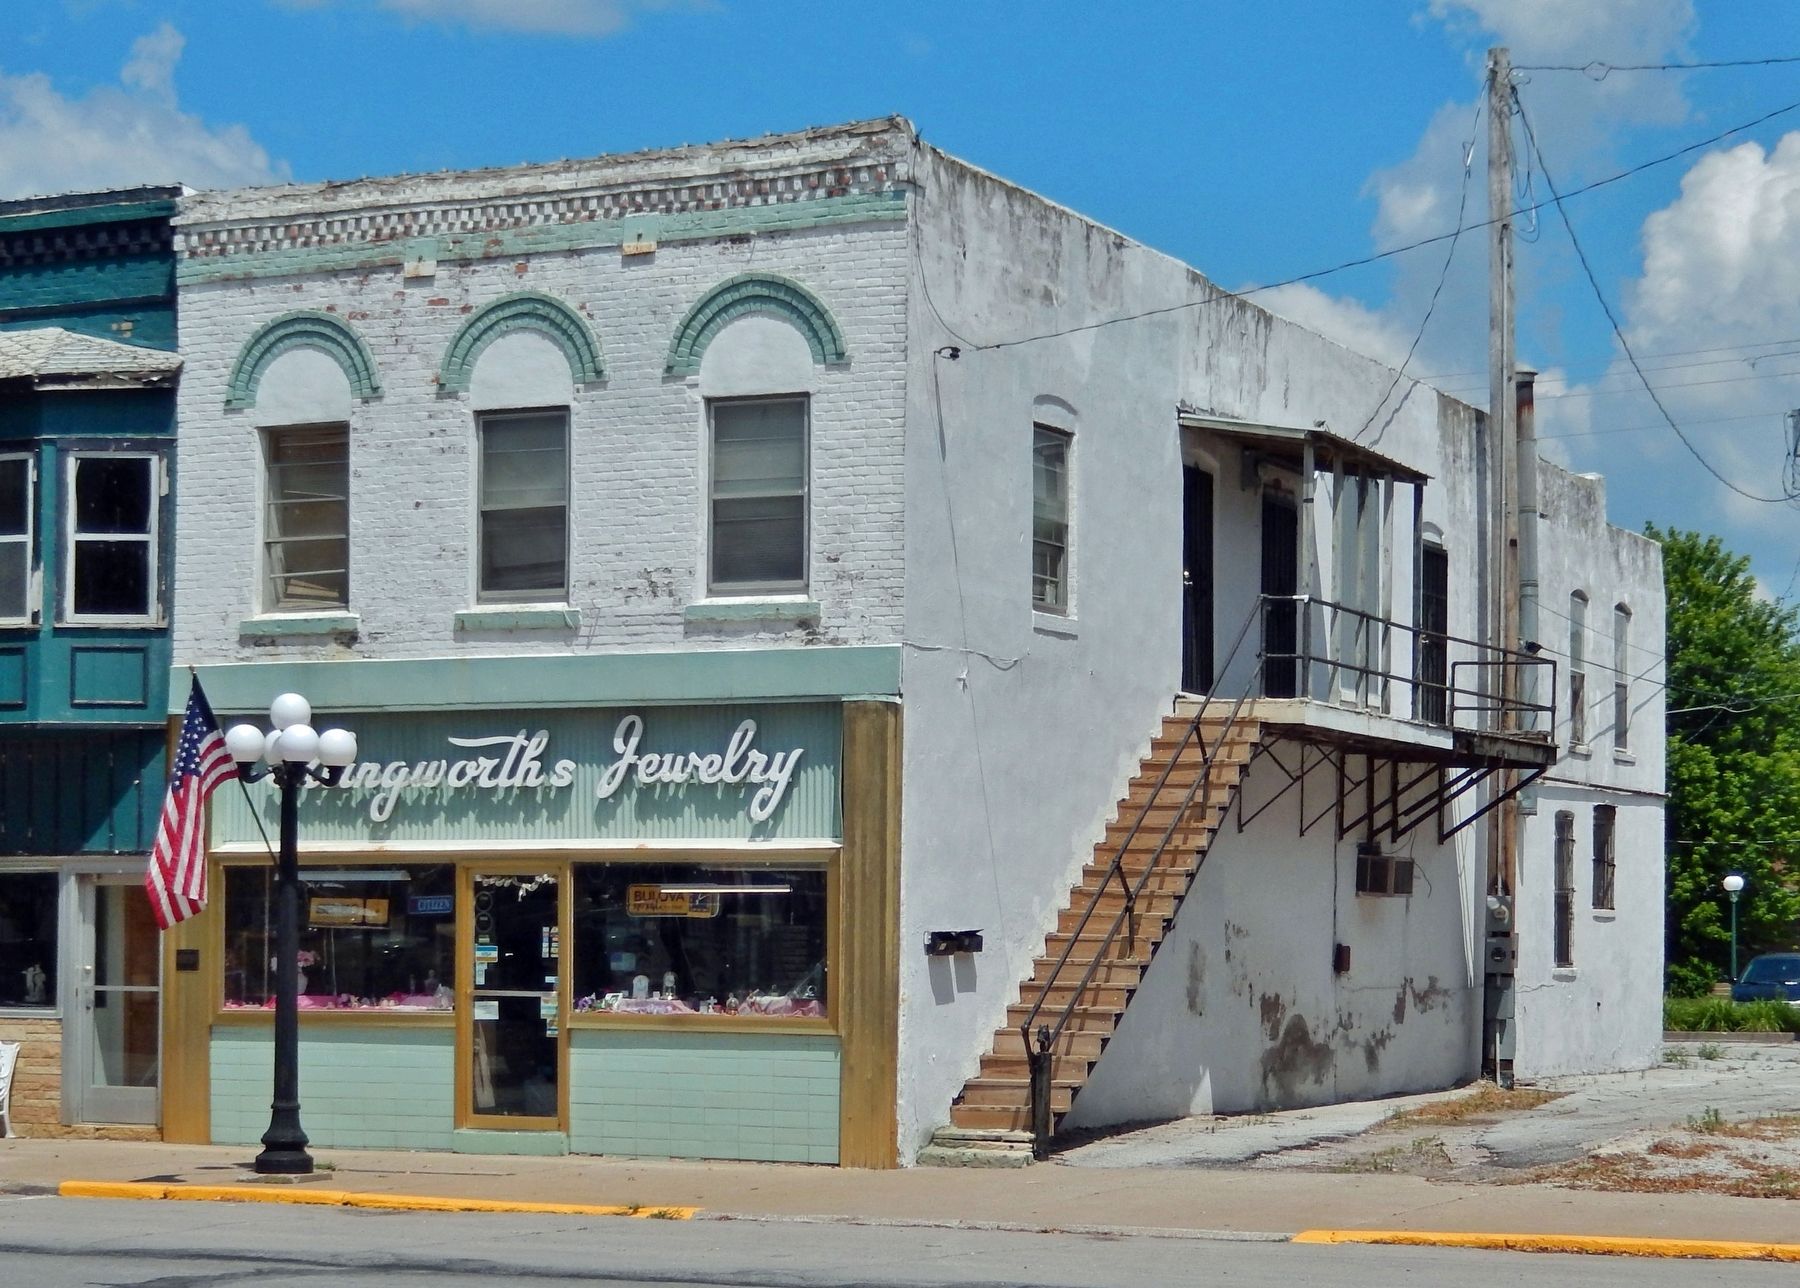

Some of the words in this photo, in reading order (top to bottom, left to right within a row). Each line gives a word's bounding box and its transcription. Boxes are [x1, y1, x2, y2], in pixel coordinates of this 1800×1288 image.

[597, 714, 804, 822] Jewelry
[634, 890, 685, 902] BULOVA
[417, 899, 451, 911] CITIZEN
